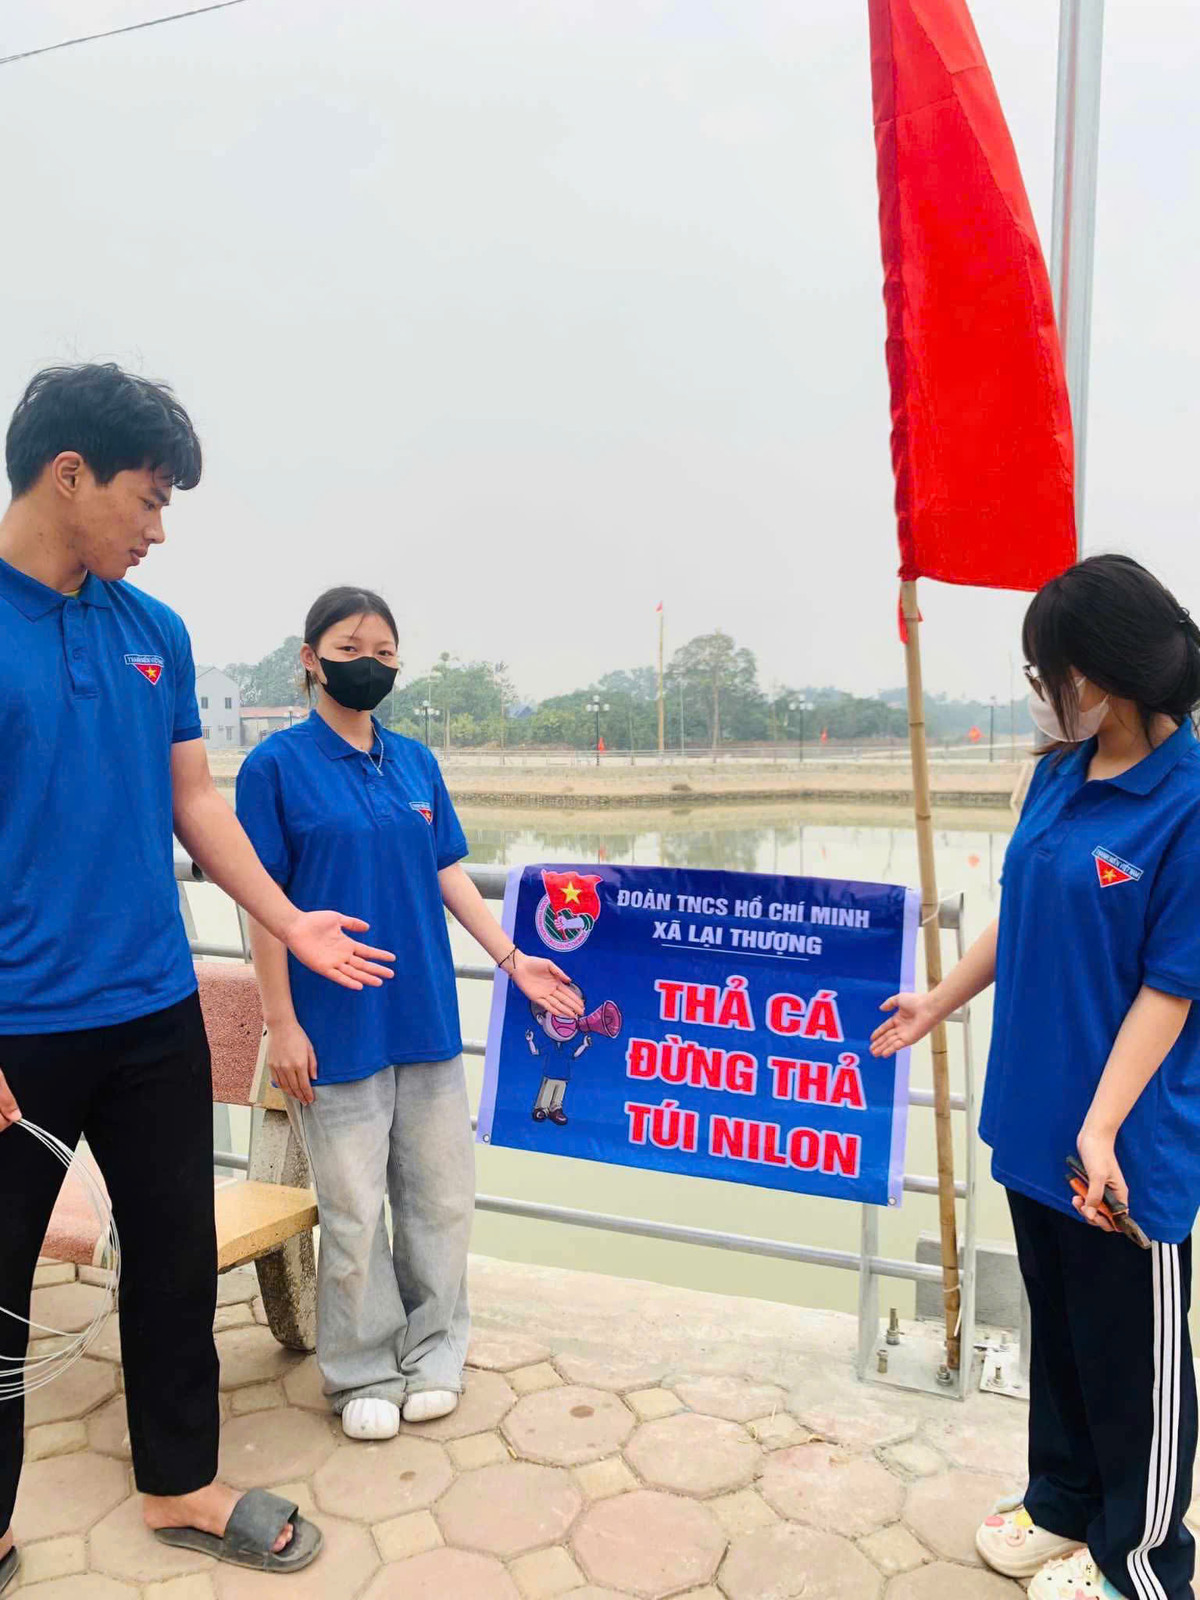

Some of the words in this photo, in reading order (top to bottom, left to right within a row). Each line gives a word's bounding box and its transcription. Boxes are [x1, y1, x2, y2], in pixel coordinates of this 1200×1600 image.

[617, 889, 671, 911] ĐOÀN
[677, 895, 728, 916] TNCS
[734, 895, 763, 919] HỒ
[768, 902, 804, 923] CHÍ
[810, 907, 870, 928] MINH
[652, 920, 682, 941] XÃ
[688, 925, 723, 948] LẠI
[729, 929, 822, 956] THƯỢNG
[654, 974, 756, 1031] THẢ
[765, 989, 844, 1043] CÁ
[626, 1033, 757, 1096] ĐỪNG
[768, 1052, 868, 1110] THẢ
[624, 1099, 699, 1153] TÚI
[708, 1114, 861, 1178] NILON
